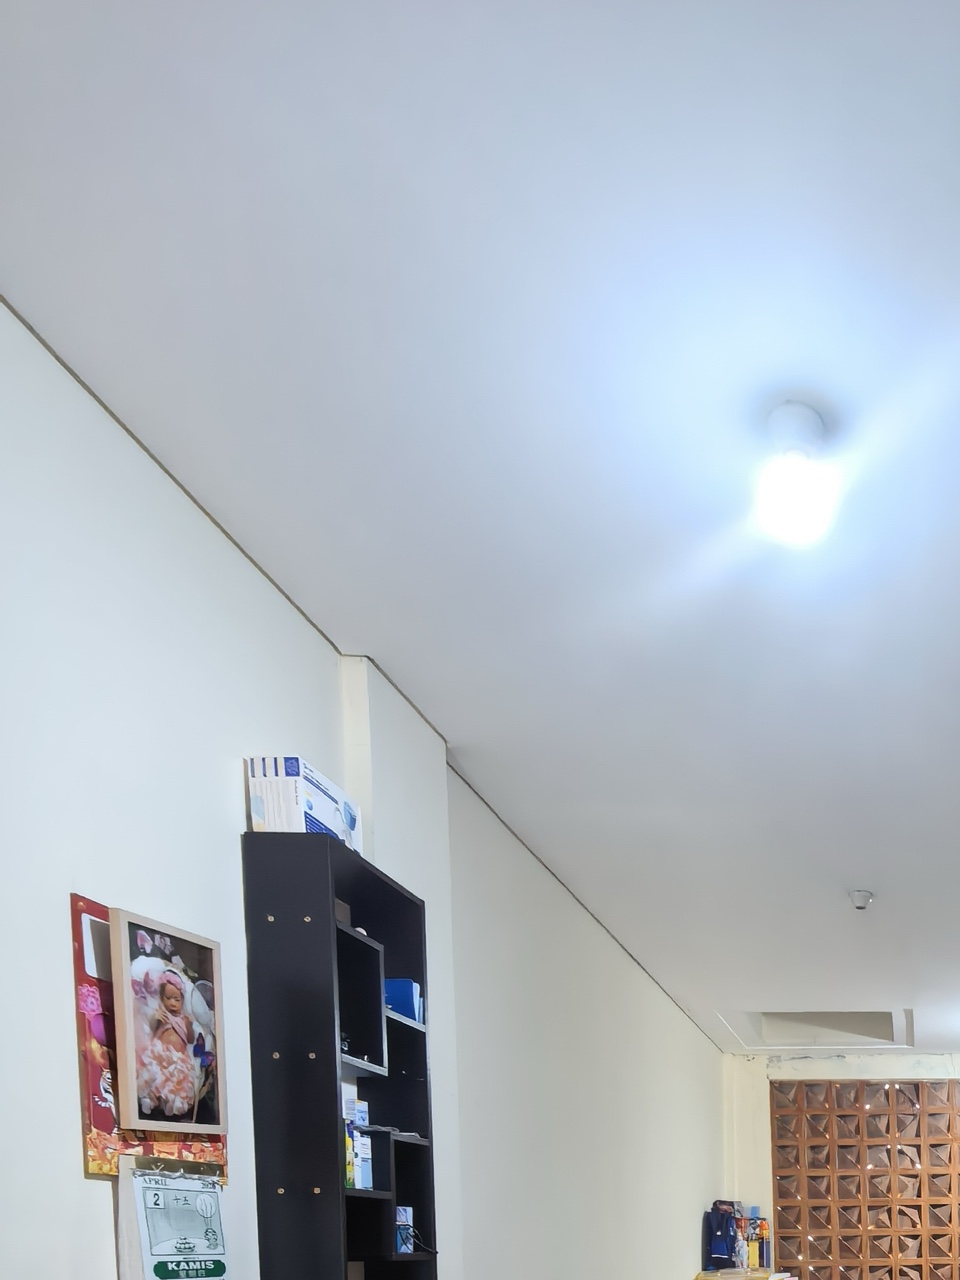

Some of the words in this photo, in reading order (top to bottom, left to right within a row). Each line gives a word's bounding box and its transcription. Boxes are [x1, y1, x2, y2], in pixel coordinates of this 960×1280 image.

[143, 1177, 169, 1186] APRIL
[153, 1192, 160, 1206] 2
[167, 1261, 215, 1271] KAMIS
